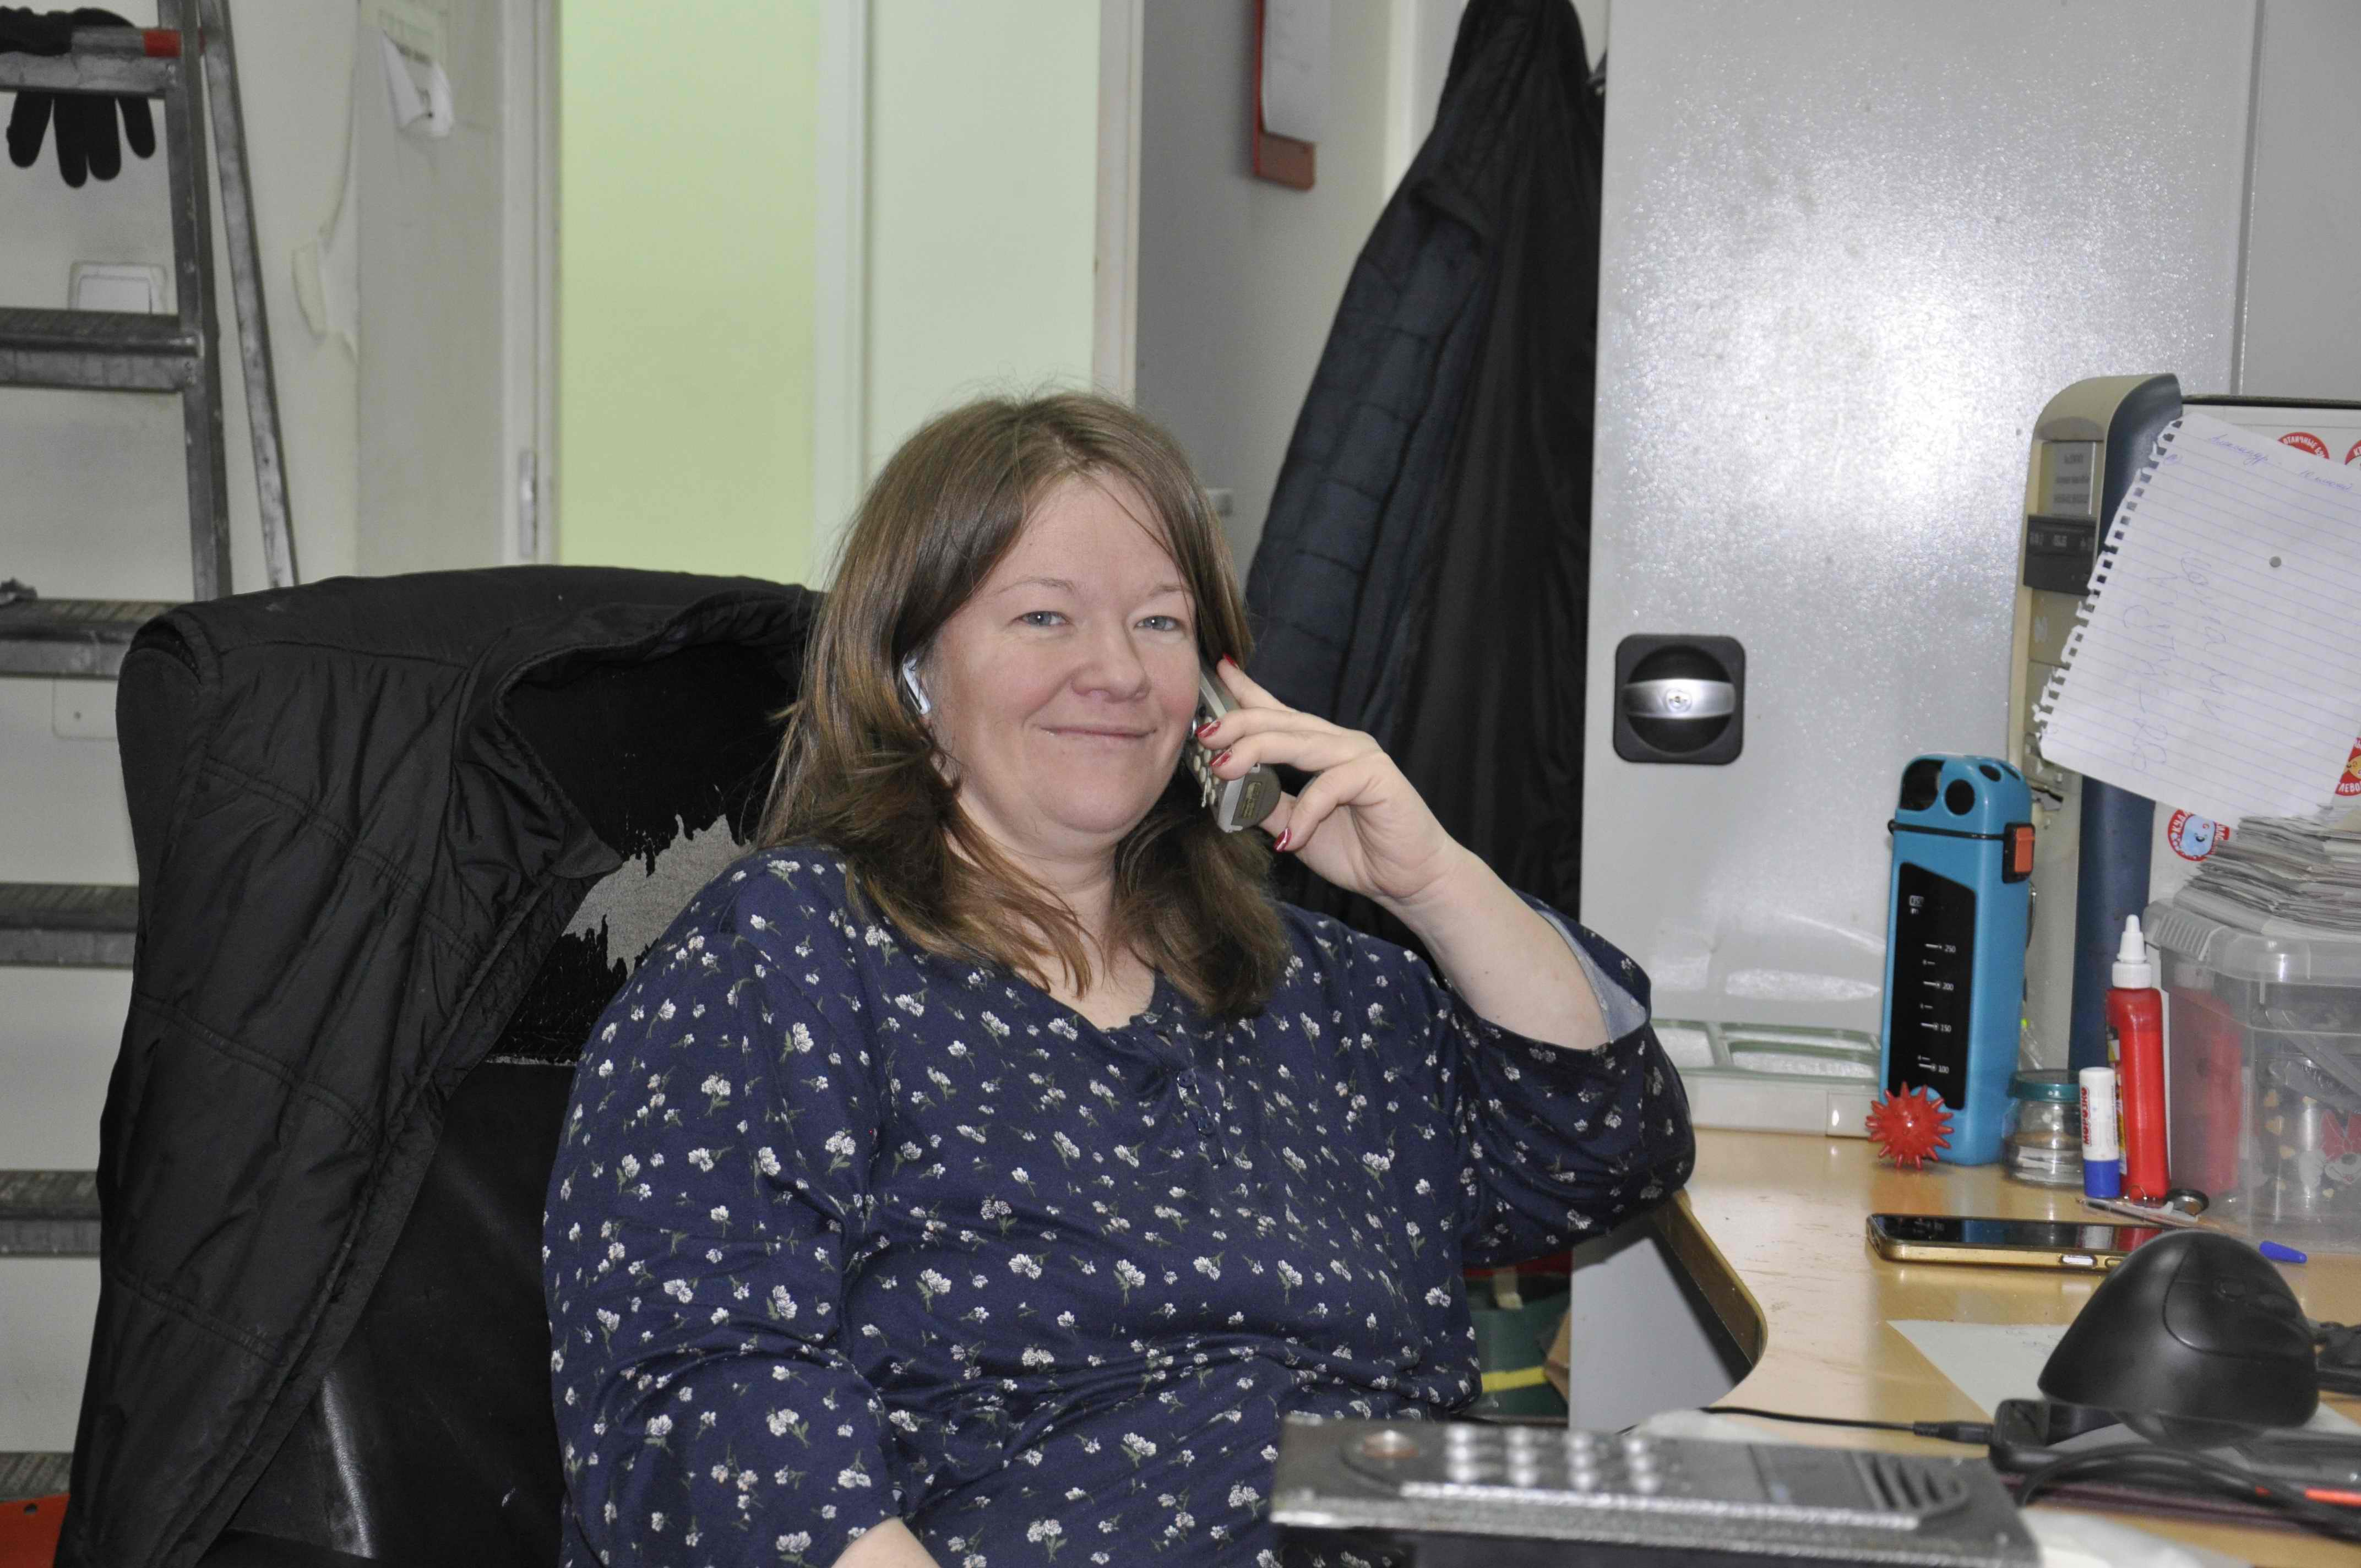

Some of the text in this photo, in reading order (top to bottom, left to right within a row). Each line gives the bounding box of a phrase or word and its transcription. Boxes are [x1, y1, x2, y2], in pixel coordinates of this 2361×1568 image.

[1944, 944, 1956, 953] 250
[1943, 982, 1954, 991] 200
[1938, 1065, 1950, 1074] 100
